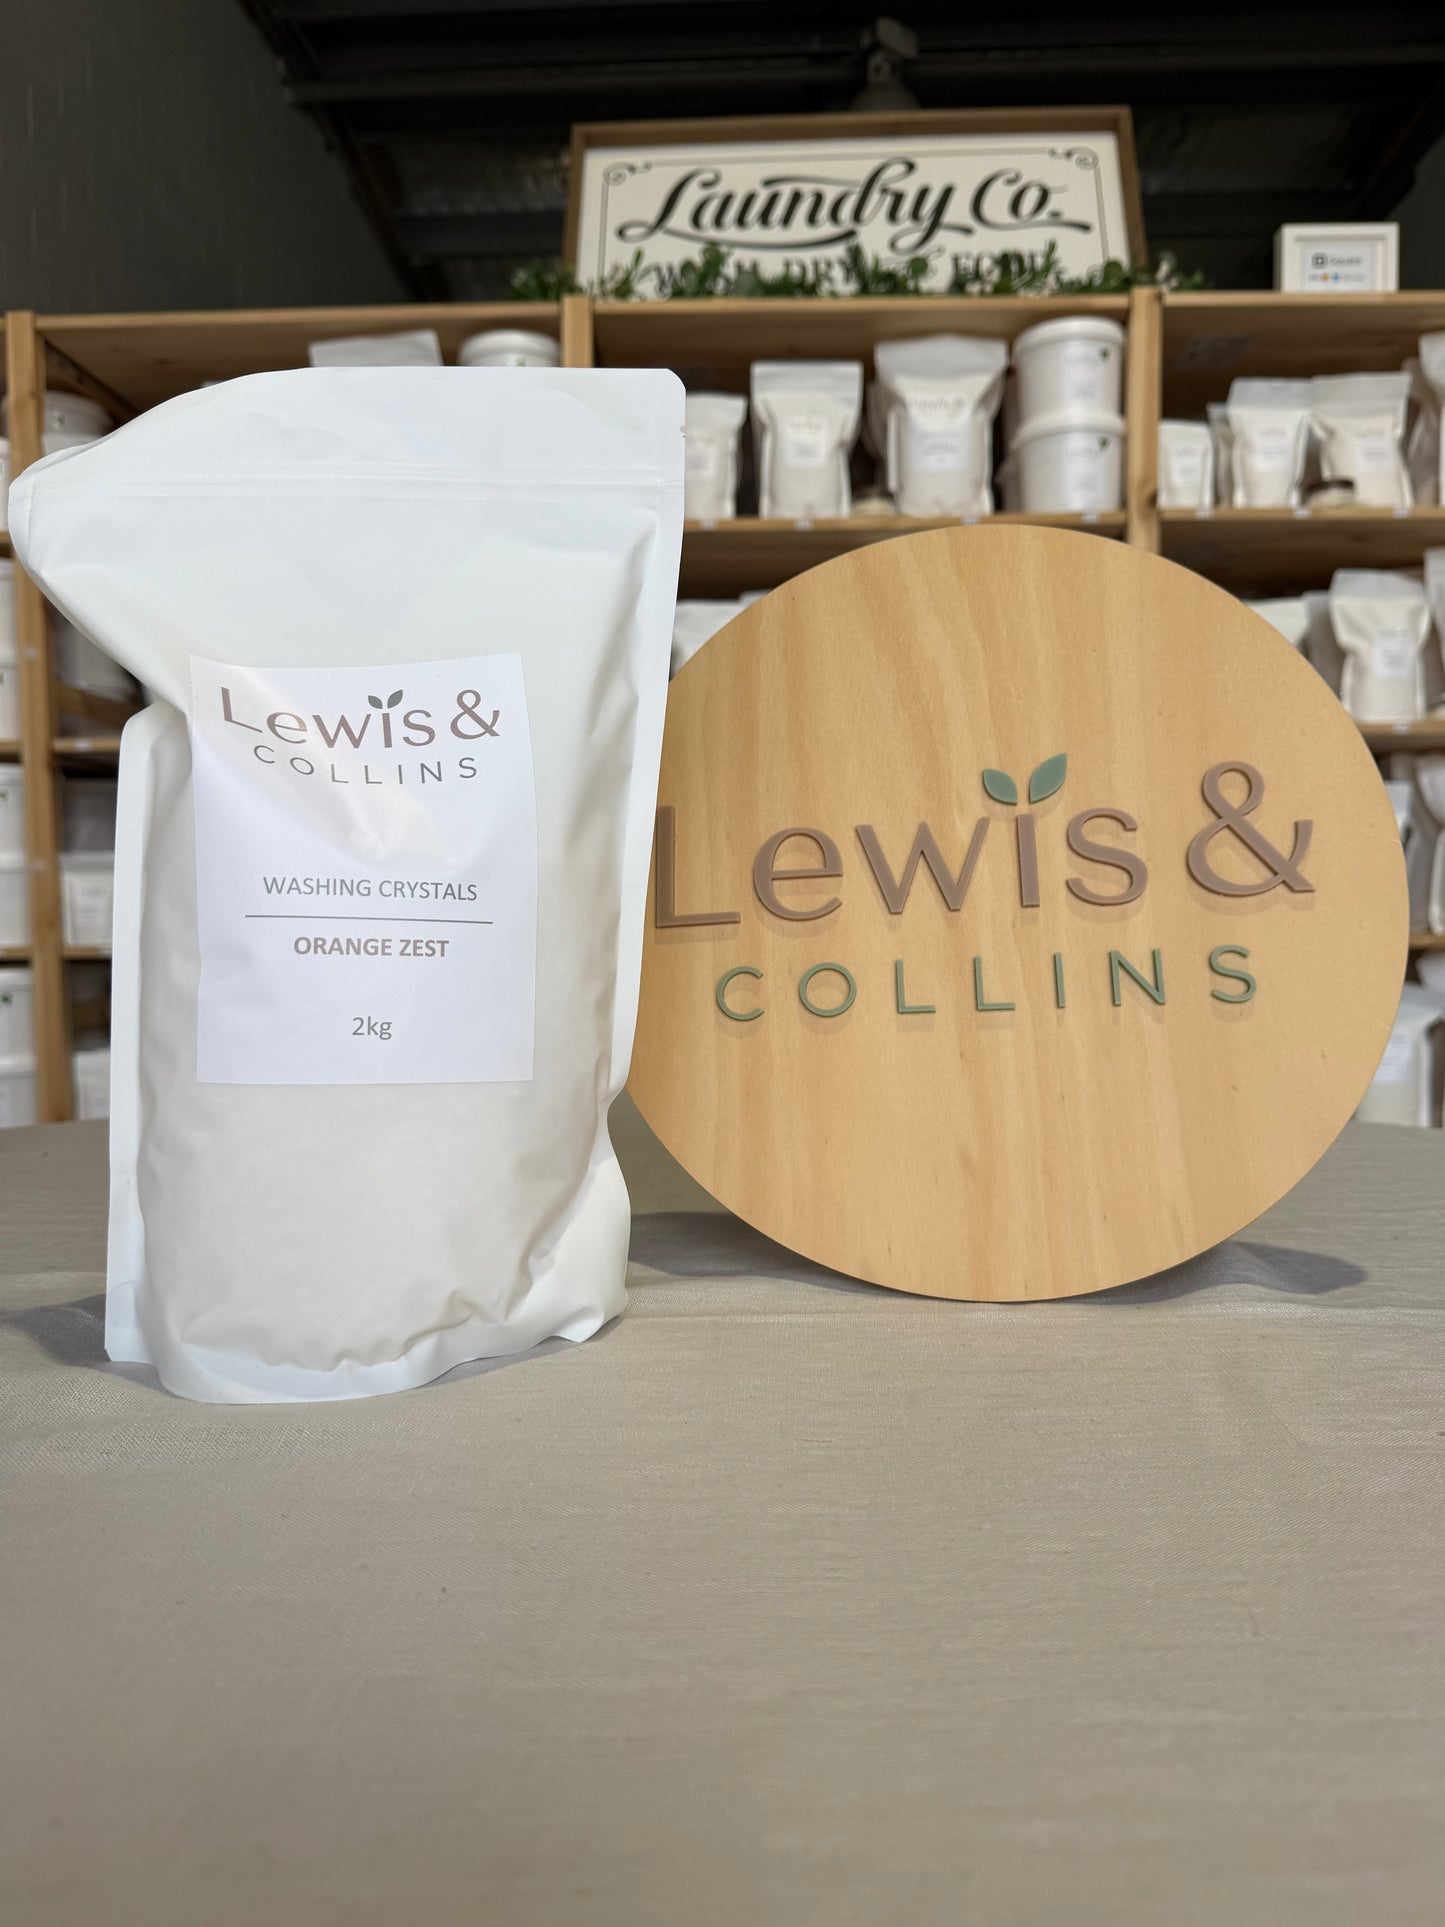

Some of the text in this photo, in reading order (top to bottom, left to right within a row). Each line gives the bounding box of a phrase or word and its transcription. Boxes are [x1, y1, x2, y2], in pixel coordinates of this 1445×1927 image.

[617, 157, 1092, 254] Laundry Co.
[220, 686, 501, 749] Lewis &
[253, 744, 478, 785] COLLINS
[655, 753, 1316, 929] Lewis &
[263, 876, 478, 901] WASHING CRYSTALS
[293, 936, 450, 958] ORANGE ZEST
[715, 944, 1258, 1022] COLLINS
[351, 1016, 393, 1040] 2kg
